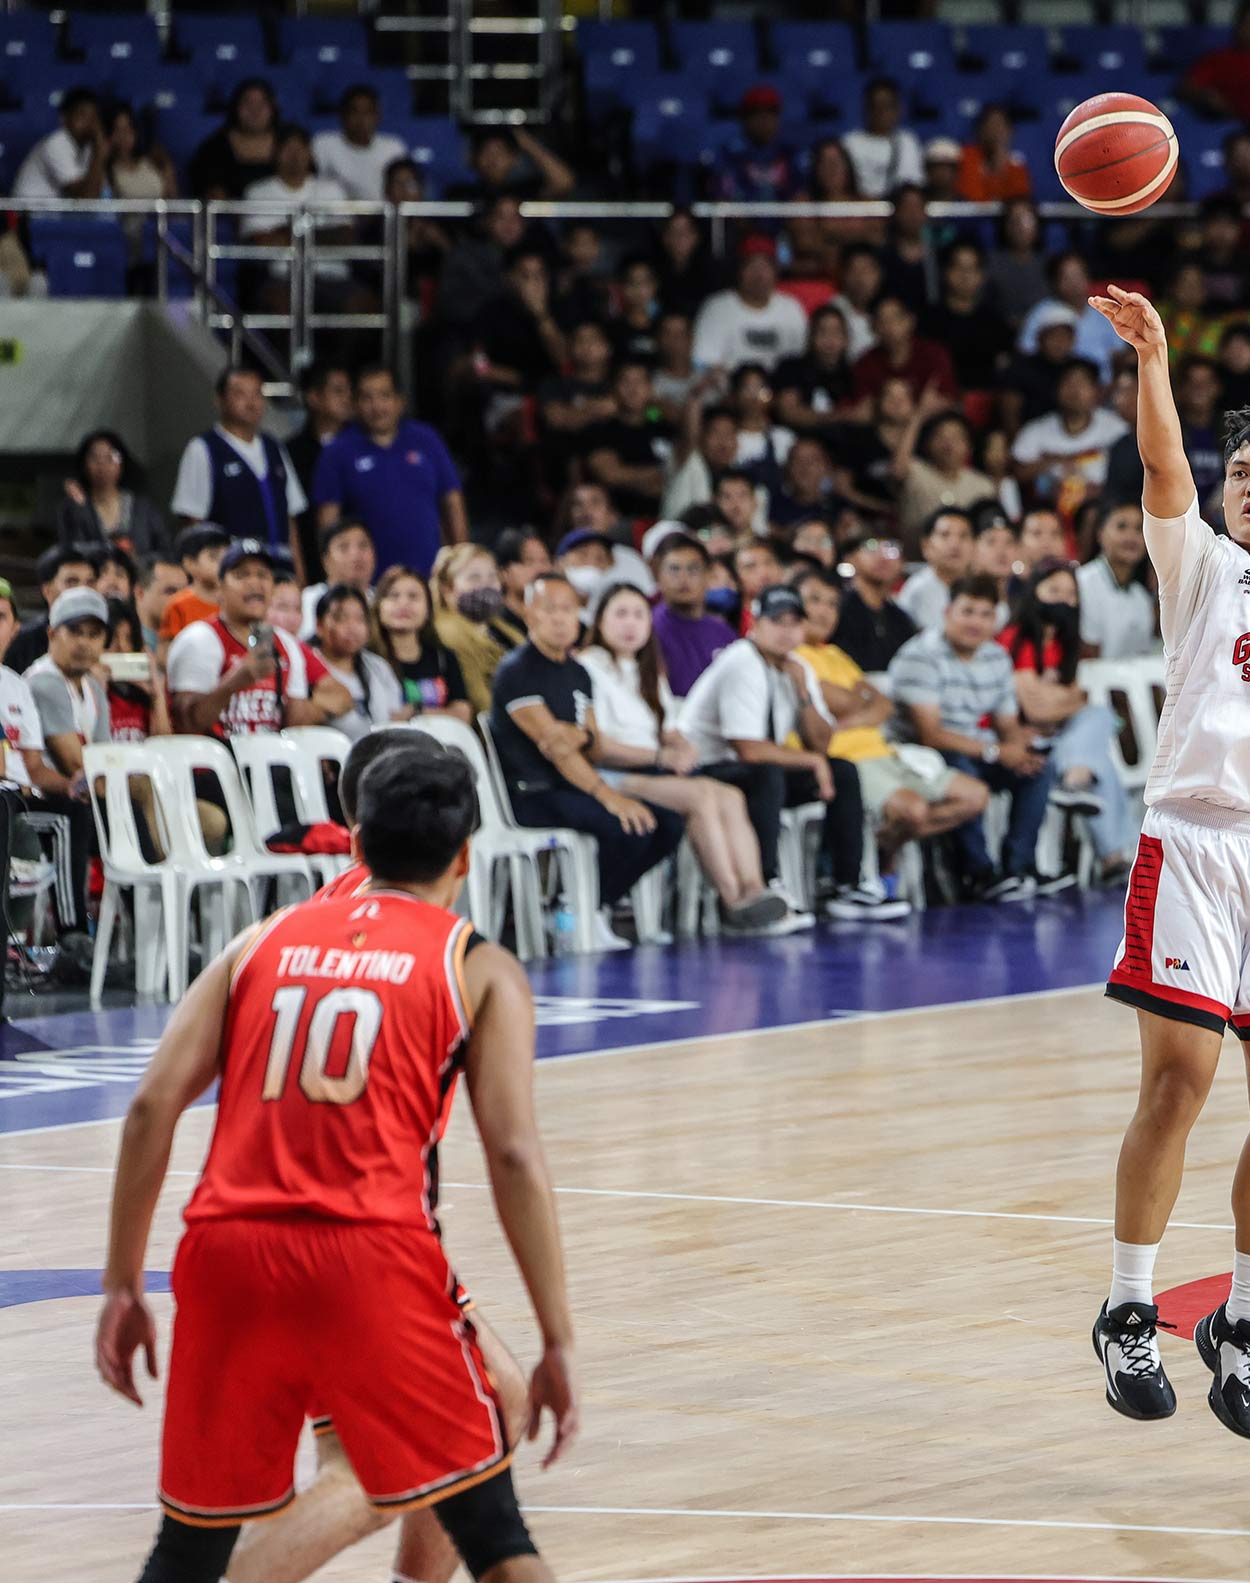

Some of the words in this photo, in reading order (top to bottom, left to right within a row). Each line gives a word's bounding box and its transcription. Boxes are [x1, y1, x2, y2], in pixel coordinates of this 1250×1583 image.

[276, 945, 416, 986] TOLENTINO
[1165, 957, 1190, 971] PBA
[262, 984, 384, 1104] 10
